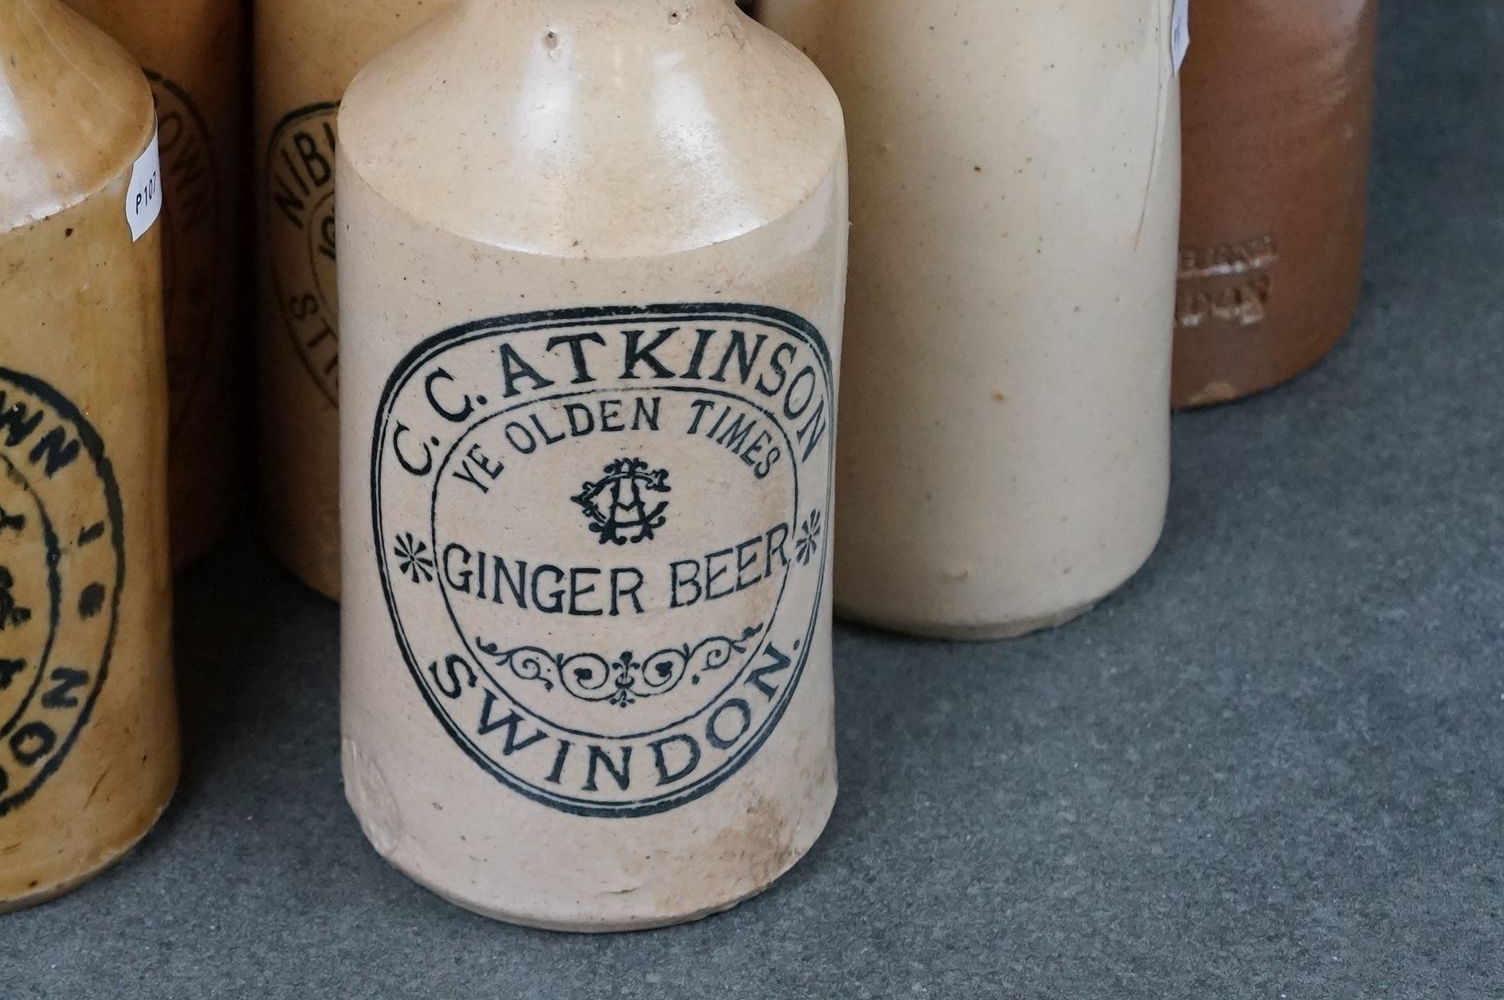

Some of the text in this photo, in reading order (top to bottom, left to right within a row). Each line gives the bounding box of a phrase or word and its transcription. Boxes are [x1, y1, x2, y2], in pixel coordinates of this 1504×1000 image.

[499, 325, 827, 464] ATKINSON
[452, 396, 782, 494] YE OLDEN TIMES
[442, 522, 792, 618] GINGER BEER
